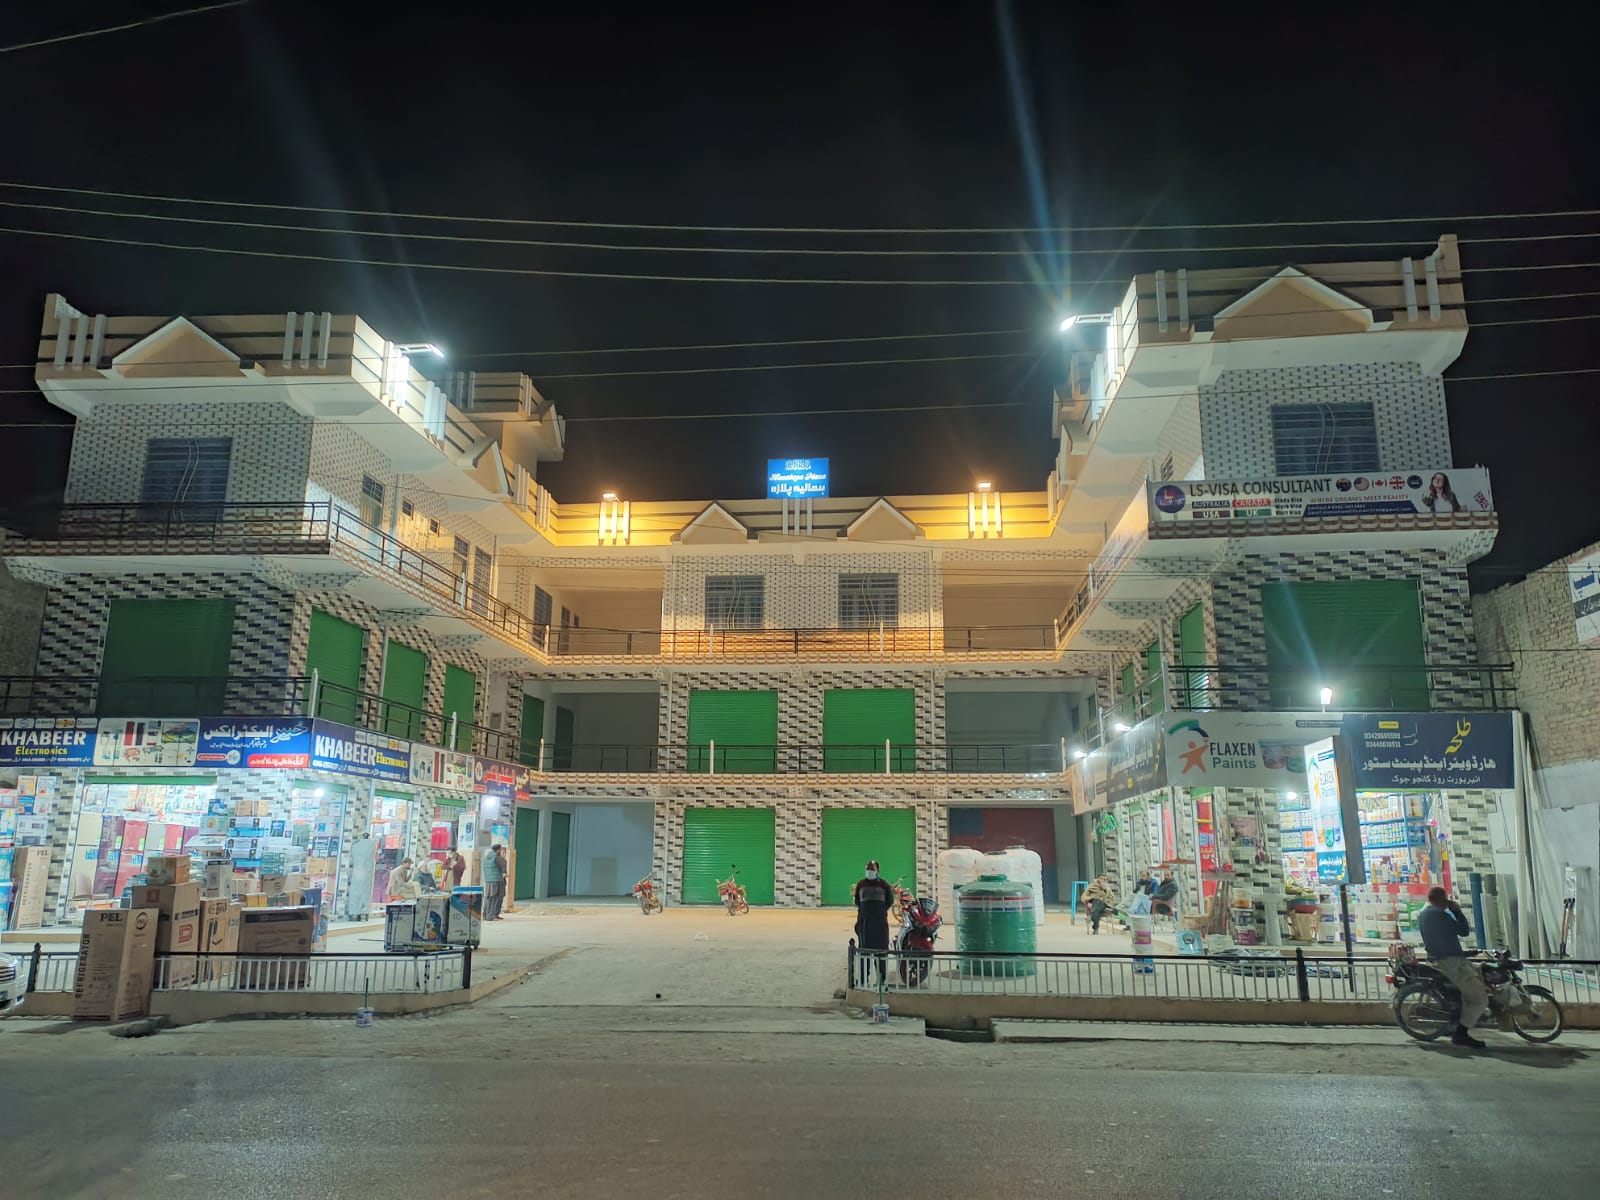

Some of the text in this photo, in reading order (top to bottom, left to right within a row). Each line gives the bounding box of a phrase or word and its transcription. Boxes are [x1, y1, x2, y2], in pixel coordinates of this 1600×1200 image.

[1189, 482, 1240, 497] LS-VISA
[1243, 478, 1333, 495] CONSULTANT
[1192, 501, 1230, 509] AUSTRALIA
[1234, 499, 1270, 507] CANADA
[1203, 510, 1220, 519] USA
[1246, 509, 1259, 517] UK
[0, 730, 87, 746] KHABEER
[1445, 716, 1472, 755] طلحہ
[314, 734, 377, 766] KHABEER
[1210, 742, 1256, 756] FLAXEN
[1212, 758, 1256, 769] Paints
[99, 912, 123, 922] PEL
[74, 933, 91, 999] REFRIGERATOR
